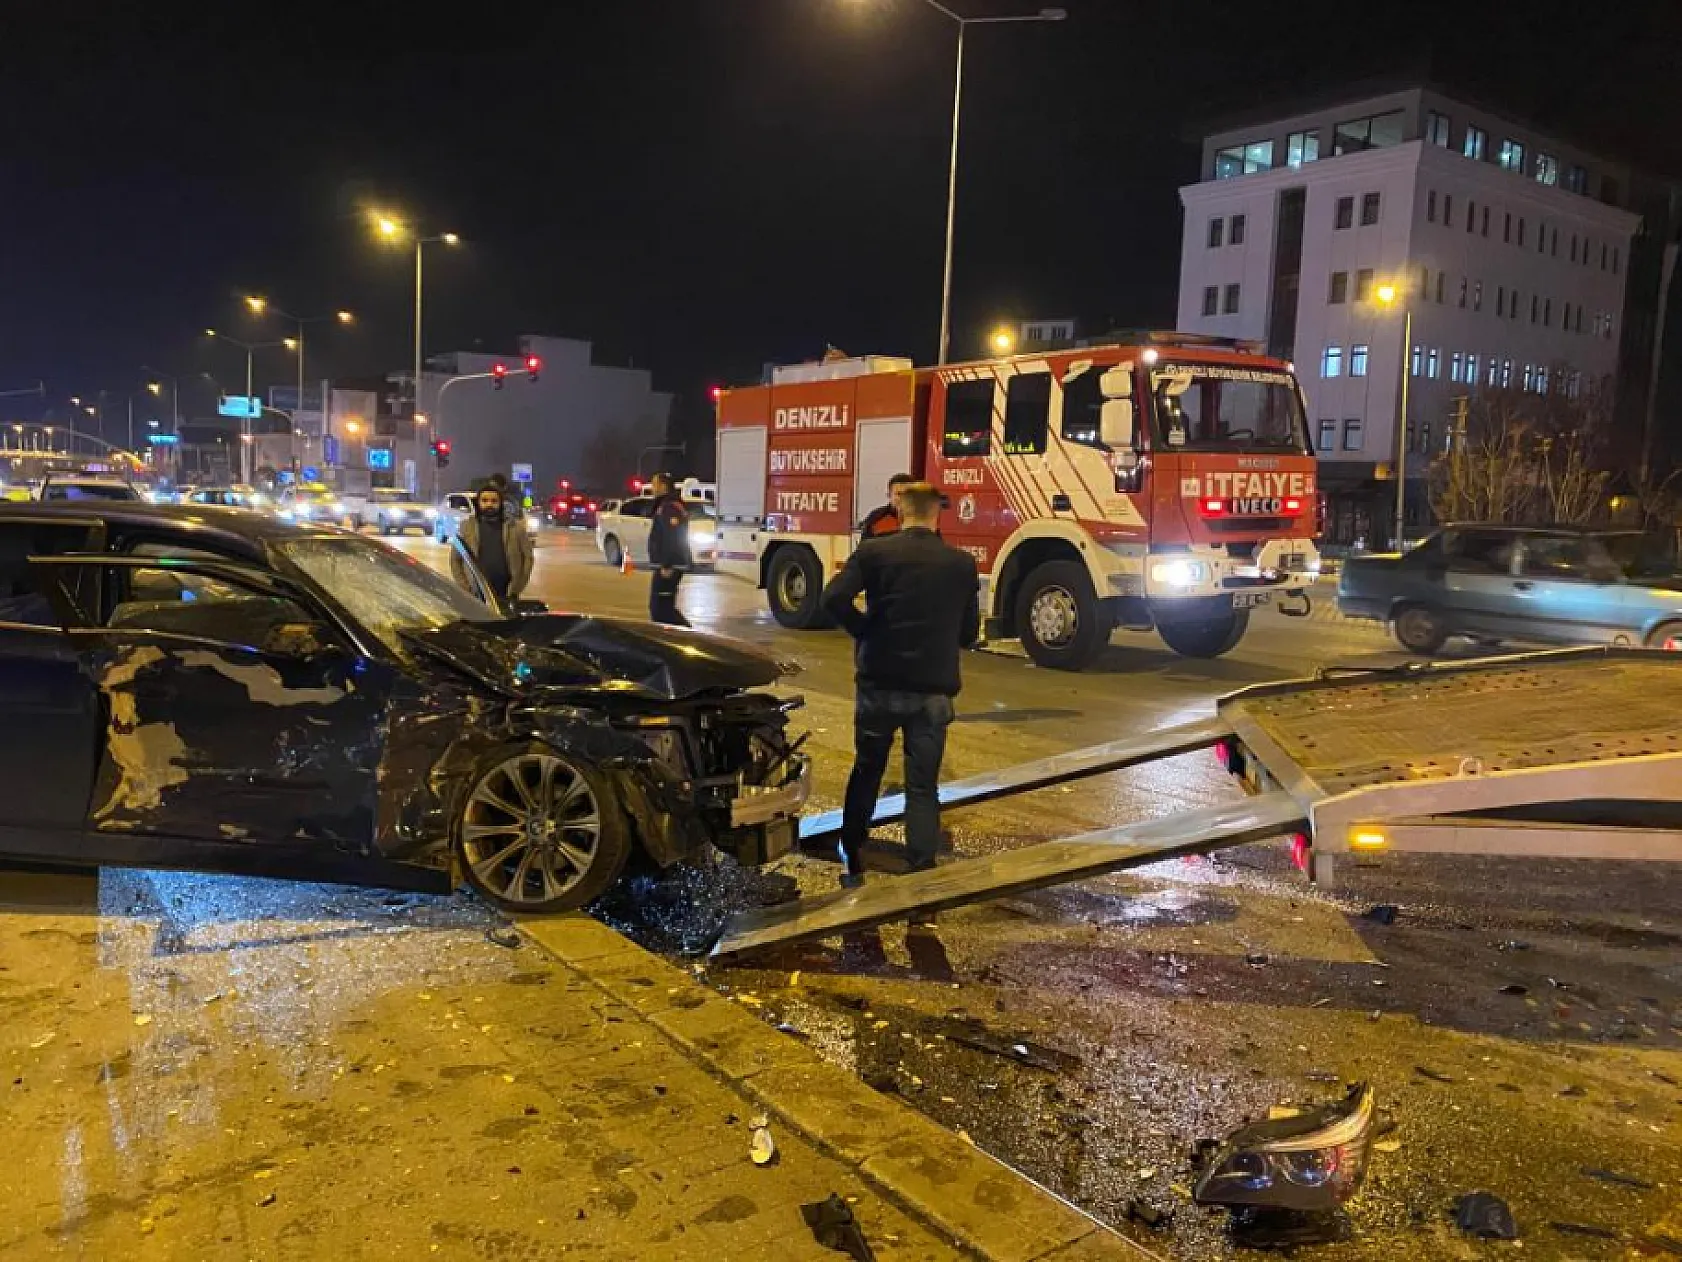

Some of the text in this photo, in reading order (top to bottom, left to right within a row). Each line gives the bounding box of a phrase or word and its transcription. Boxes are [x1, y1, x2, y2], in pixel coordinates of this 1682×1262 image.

[775, 404, 849, 429] DENİZLİ
[770, 448, 847, 473] BÜYÜKŞEHİR
[943, 468, 984, 485] DENİZLİ
[1204, 472, 1304, 498] İTFAİYE
[777, 491, 839, 512] İTFAİYE
[1232, 498, 1282, 515] IVECO
